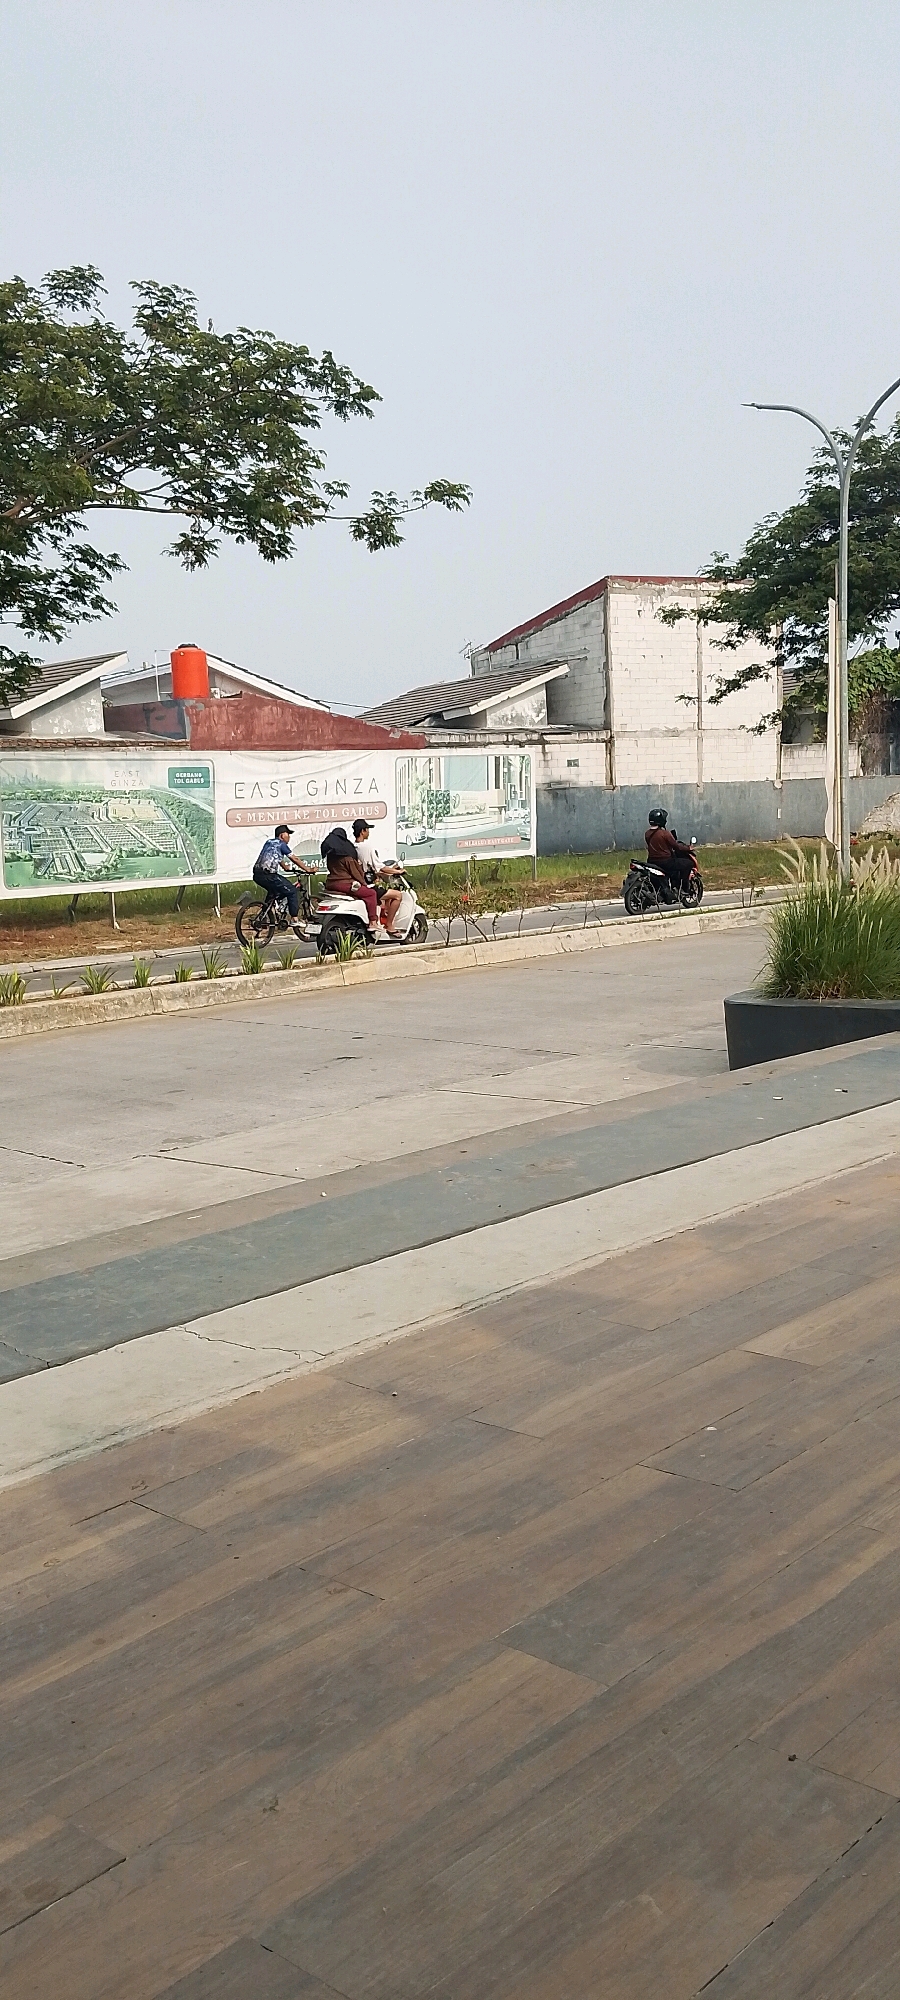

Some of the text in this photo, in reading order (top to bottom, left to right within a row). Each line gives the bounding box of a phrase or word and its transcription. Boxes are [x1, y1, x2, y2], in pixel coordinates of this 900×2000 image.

[115, 770, 140, 778] EAST
[110, 779, 145, 787] GINZA
[234, 777, 379, 799] EAST GINZA
[234, 806, 380, 823] 5 MENIT KE TOL GABUS
